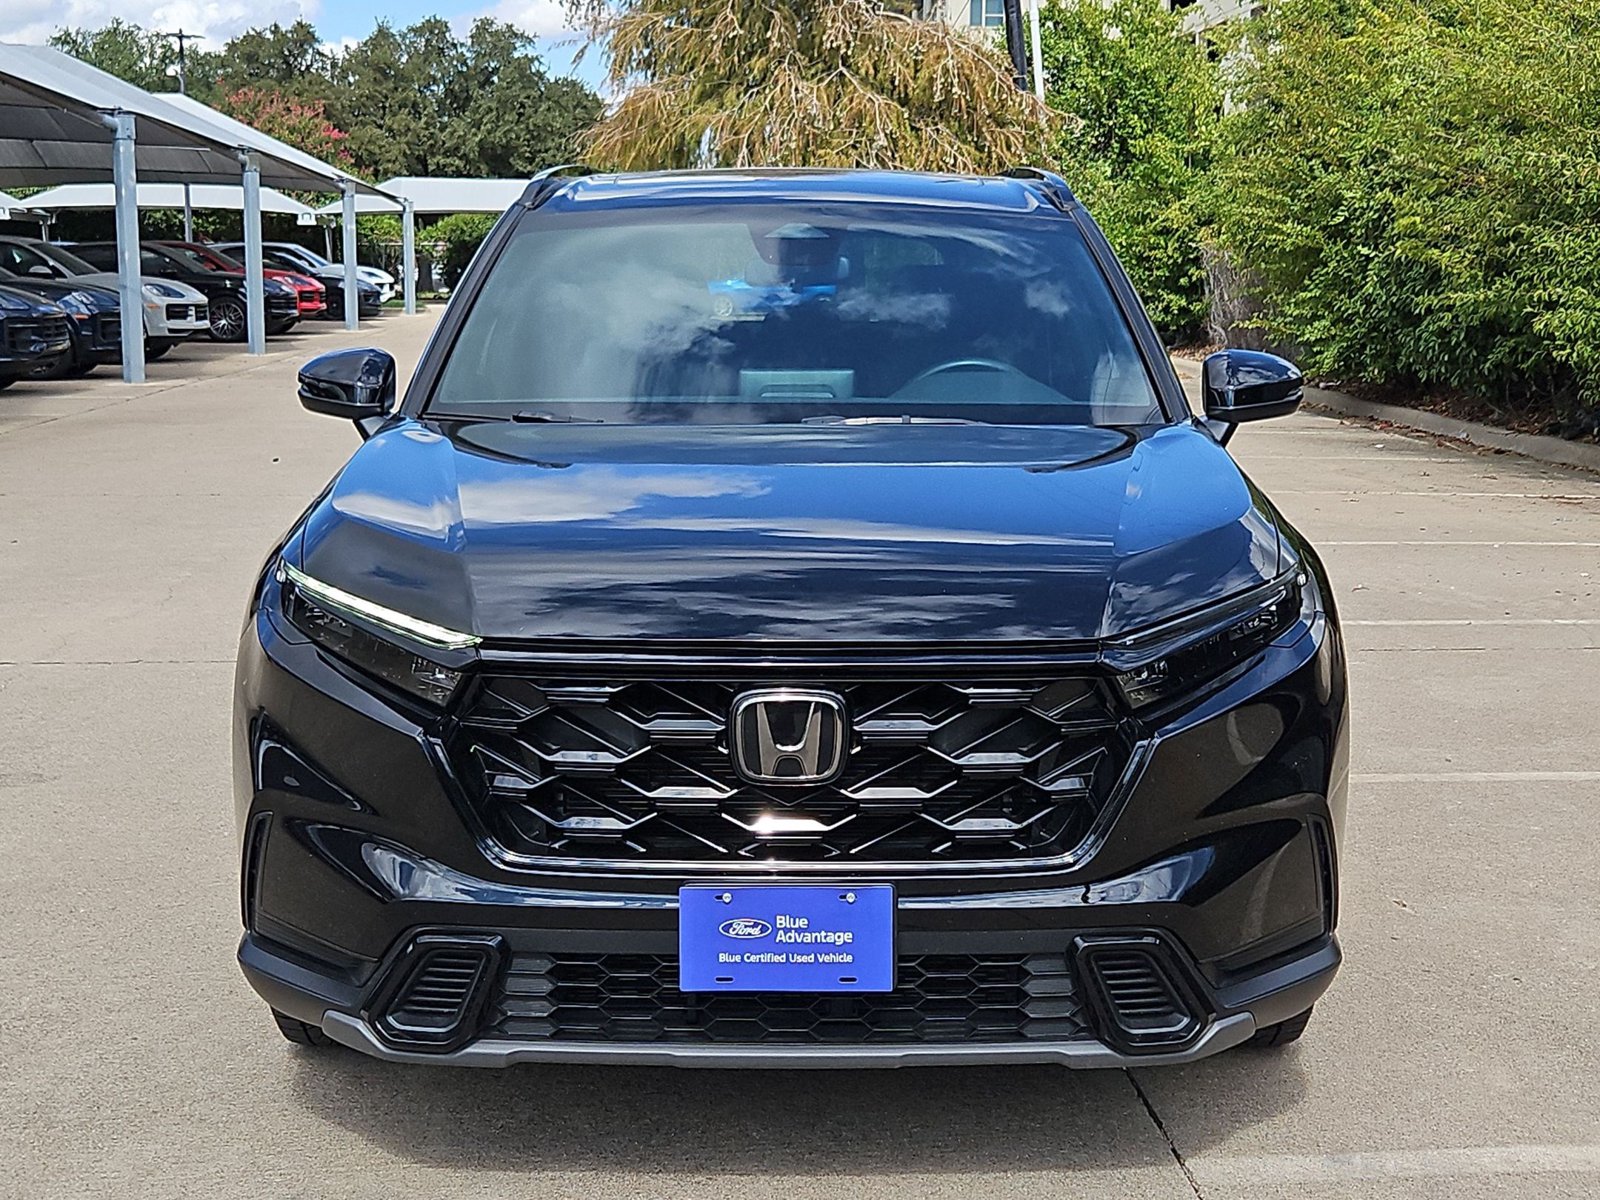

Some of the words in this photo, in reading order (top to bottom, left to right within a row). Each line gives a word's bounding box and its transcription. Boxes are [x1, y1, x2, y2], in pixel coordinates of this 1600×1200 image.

[728, 920, 763, 937] Ford
[775, 914, 809, 929] Blue
[775, 929, 853, 946] Advantage
[718, 952, 742, 963] Blue
[743, 952, 786, 963] Certified
[789, 952, 815, 963] Used
[817, 952, 853, 963] Vehicle
